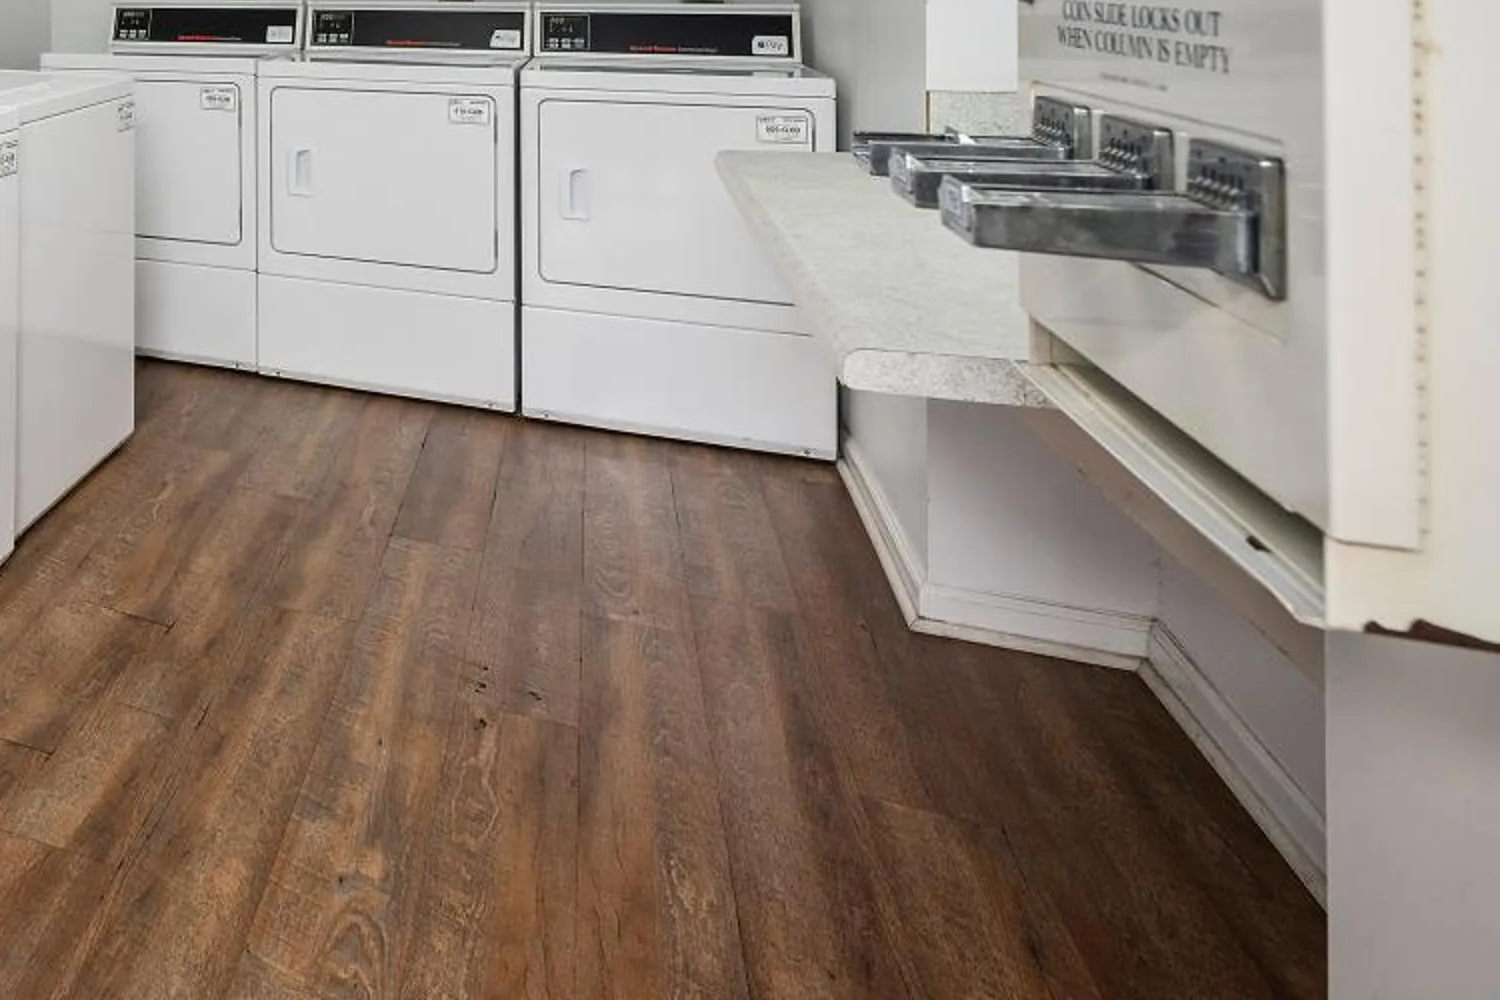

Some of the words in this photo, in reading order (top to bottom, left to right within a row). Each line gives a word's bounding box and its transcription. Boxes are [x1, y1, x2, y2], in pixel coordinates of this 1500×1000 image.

[1062, 0, 1092, 22] COIN
[1094, 2, 1129, 28] SLIDE
[1130, 5, 1181, 34] LOCKS
[1184, 9, 1222, 38] OUT
[1057, 25, 1093, 51] WHEN
[1094, 30, 1153, 61] COLUMN
[1157, 37, 1171, 64] IS
[1174, 41, 1230, 74] EMPTY
